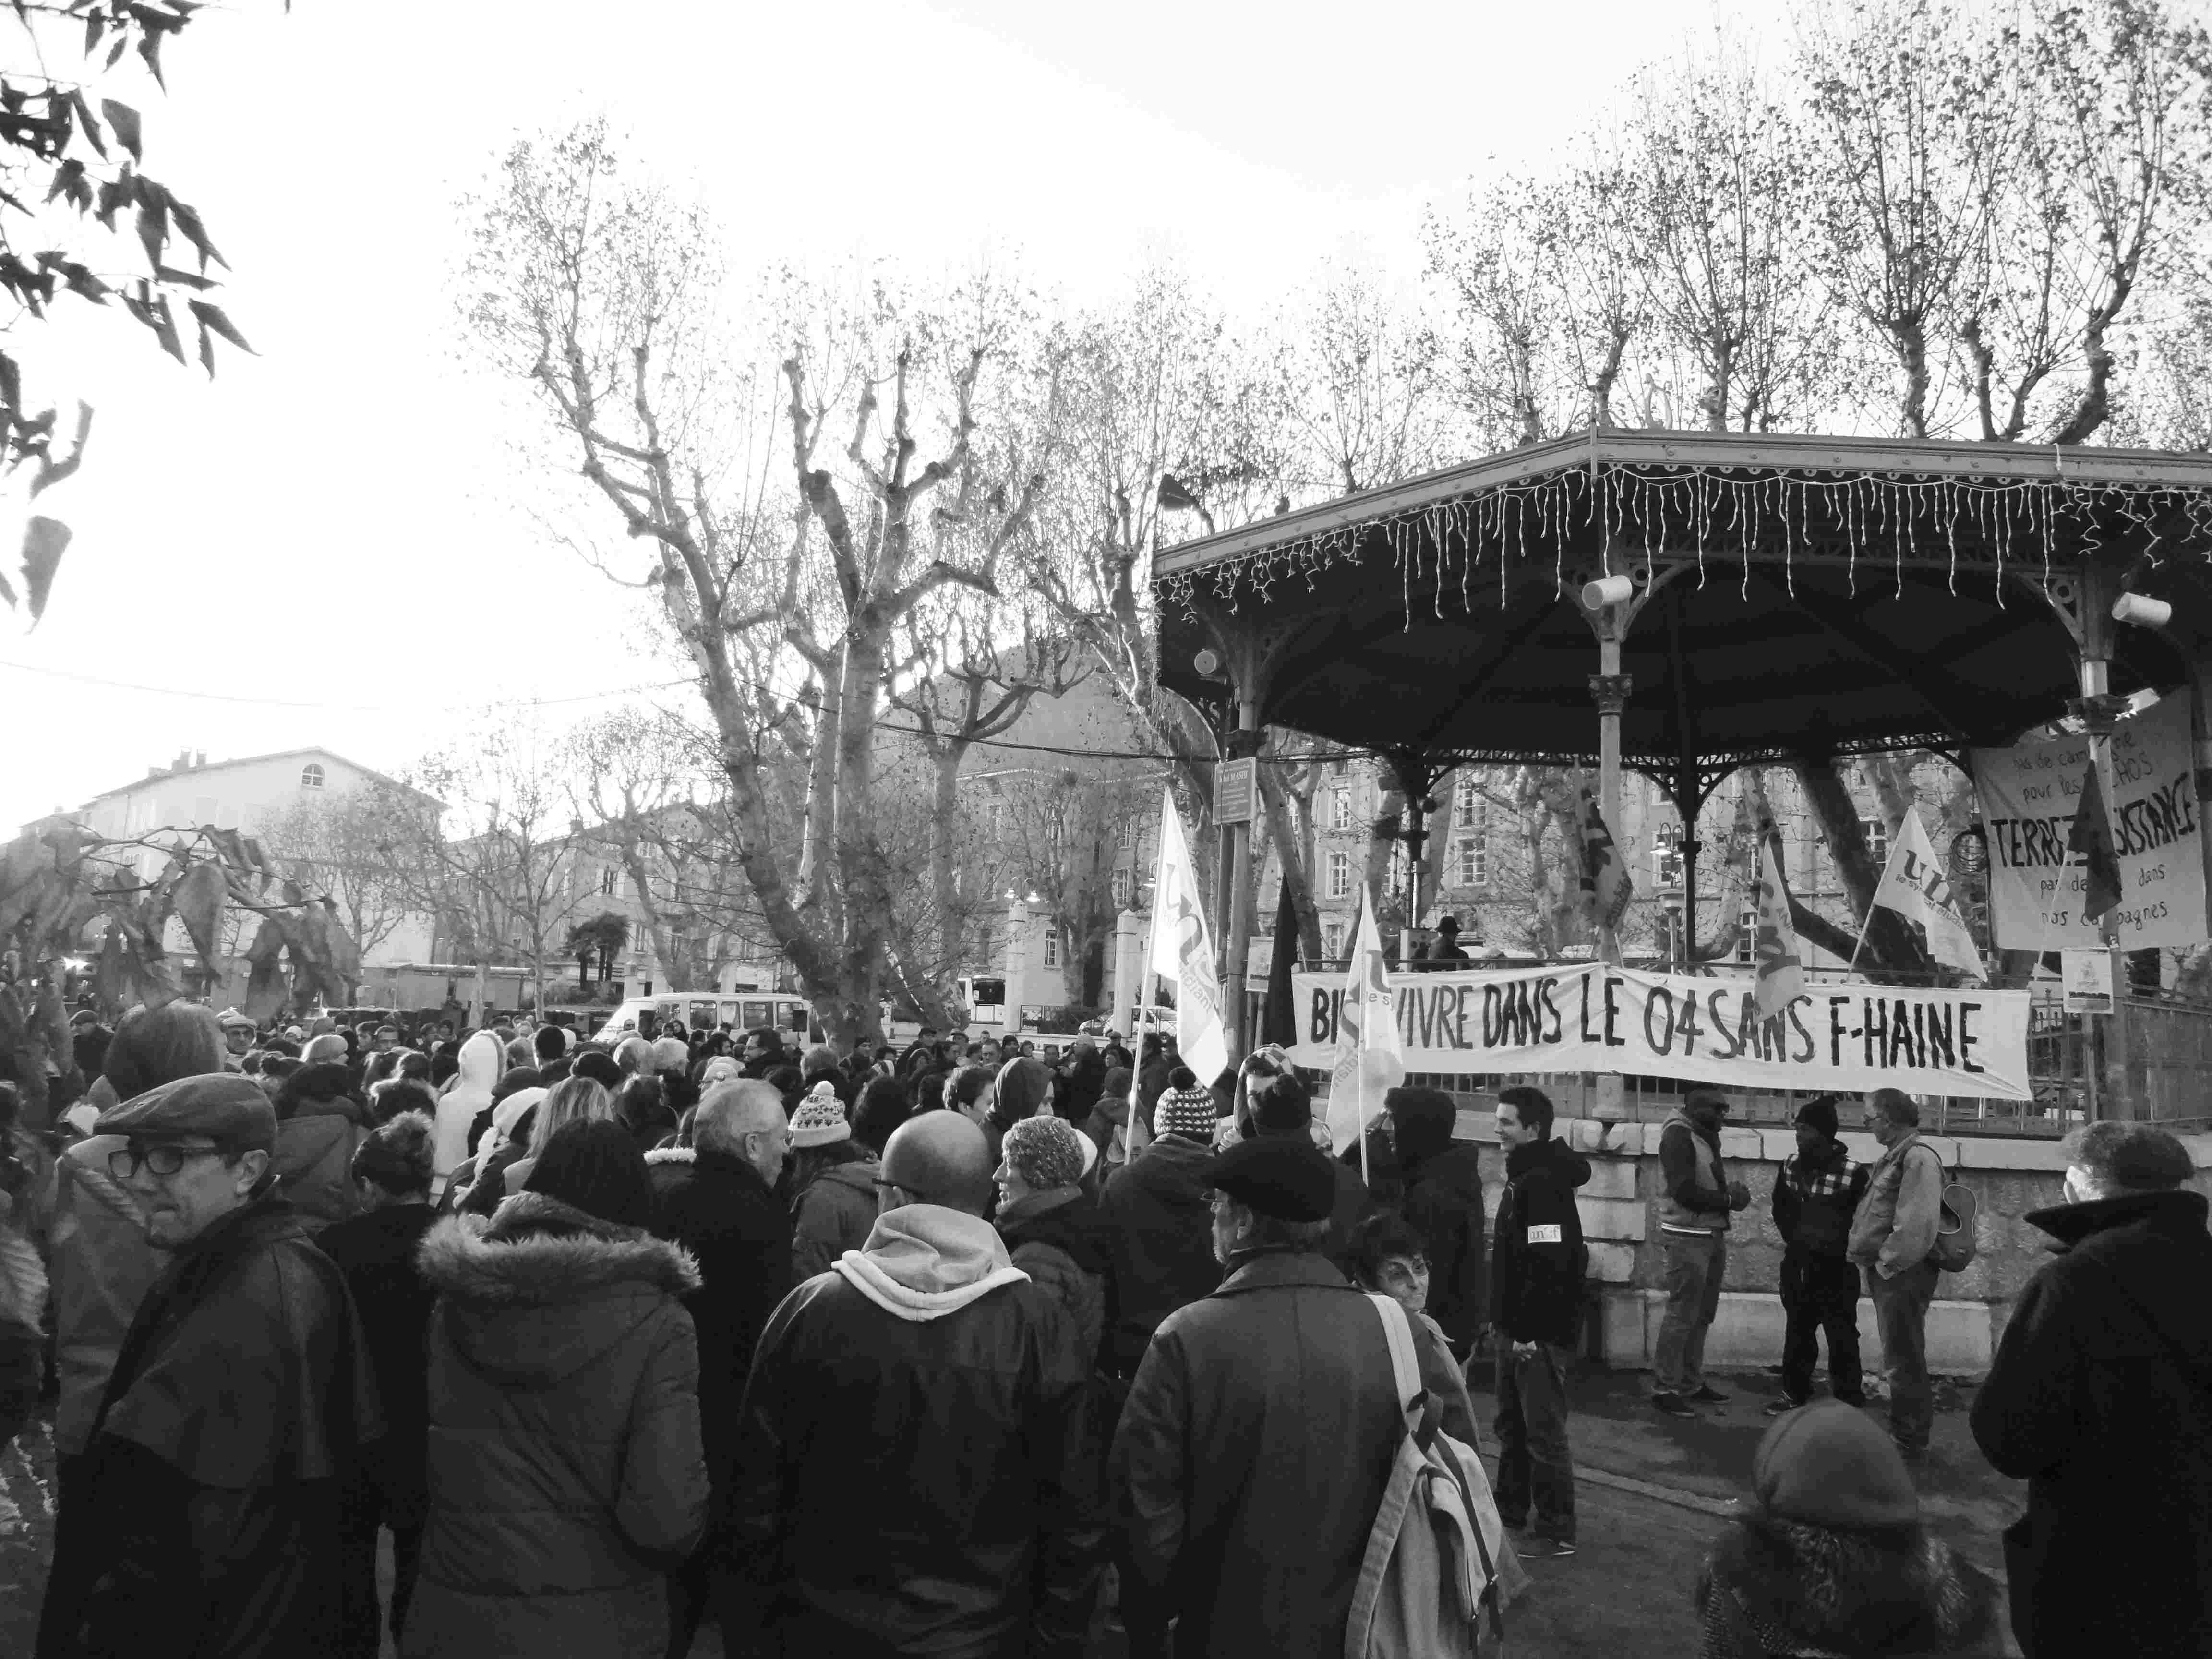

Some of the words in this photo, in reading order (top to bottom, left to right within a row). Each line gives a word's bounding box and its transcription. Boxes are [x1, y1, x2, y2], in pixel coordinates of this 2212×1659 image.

[2022, 784, 2052, 805] pour
[2058, 773, 2081, 795] les
[2138, 864, 2165, 887] dans
[2041, 911, 2068, 926] nos
[2080, 901, 2168, 931] caagnes
[1482, 977, 1562, 1048] DANS
[1580, 973, 1625, 1047] LE
[1707, 989, 1815, 1063] SANS
[1829, 995, 1985, 1073] F-HAINE
